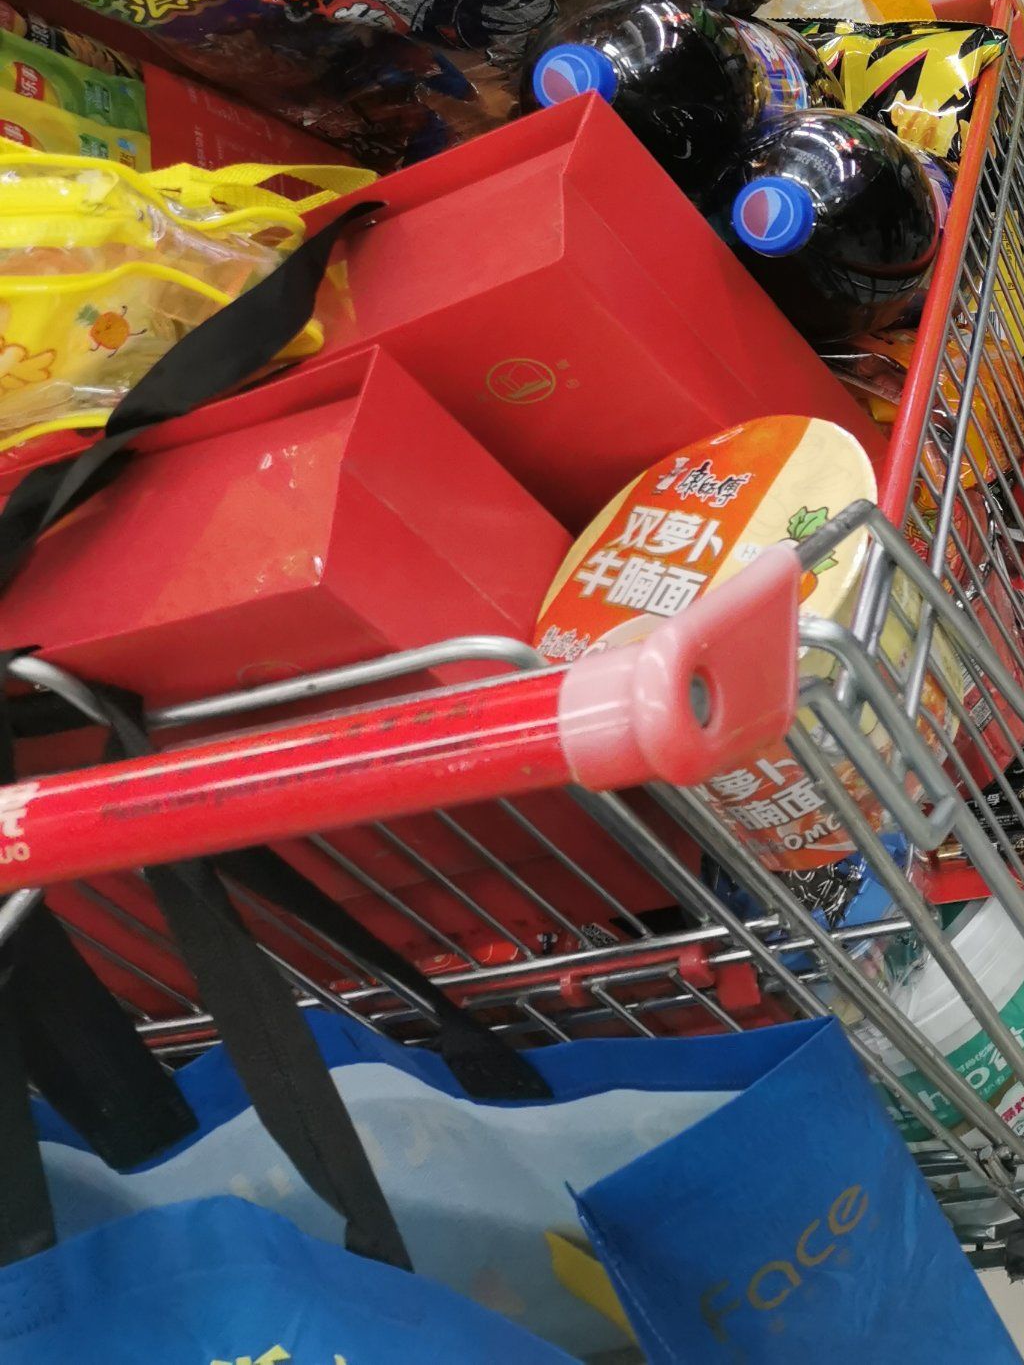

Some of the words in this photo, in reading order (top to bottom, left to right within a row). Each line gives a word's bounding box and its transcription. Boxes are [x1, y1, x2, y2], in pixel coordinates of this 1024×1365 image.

[608, 505, 724, 563] 双萝卜
[575, 550, 708, 618] 牛腩面
